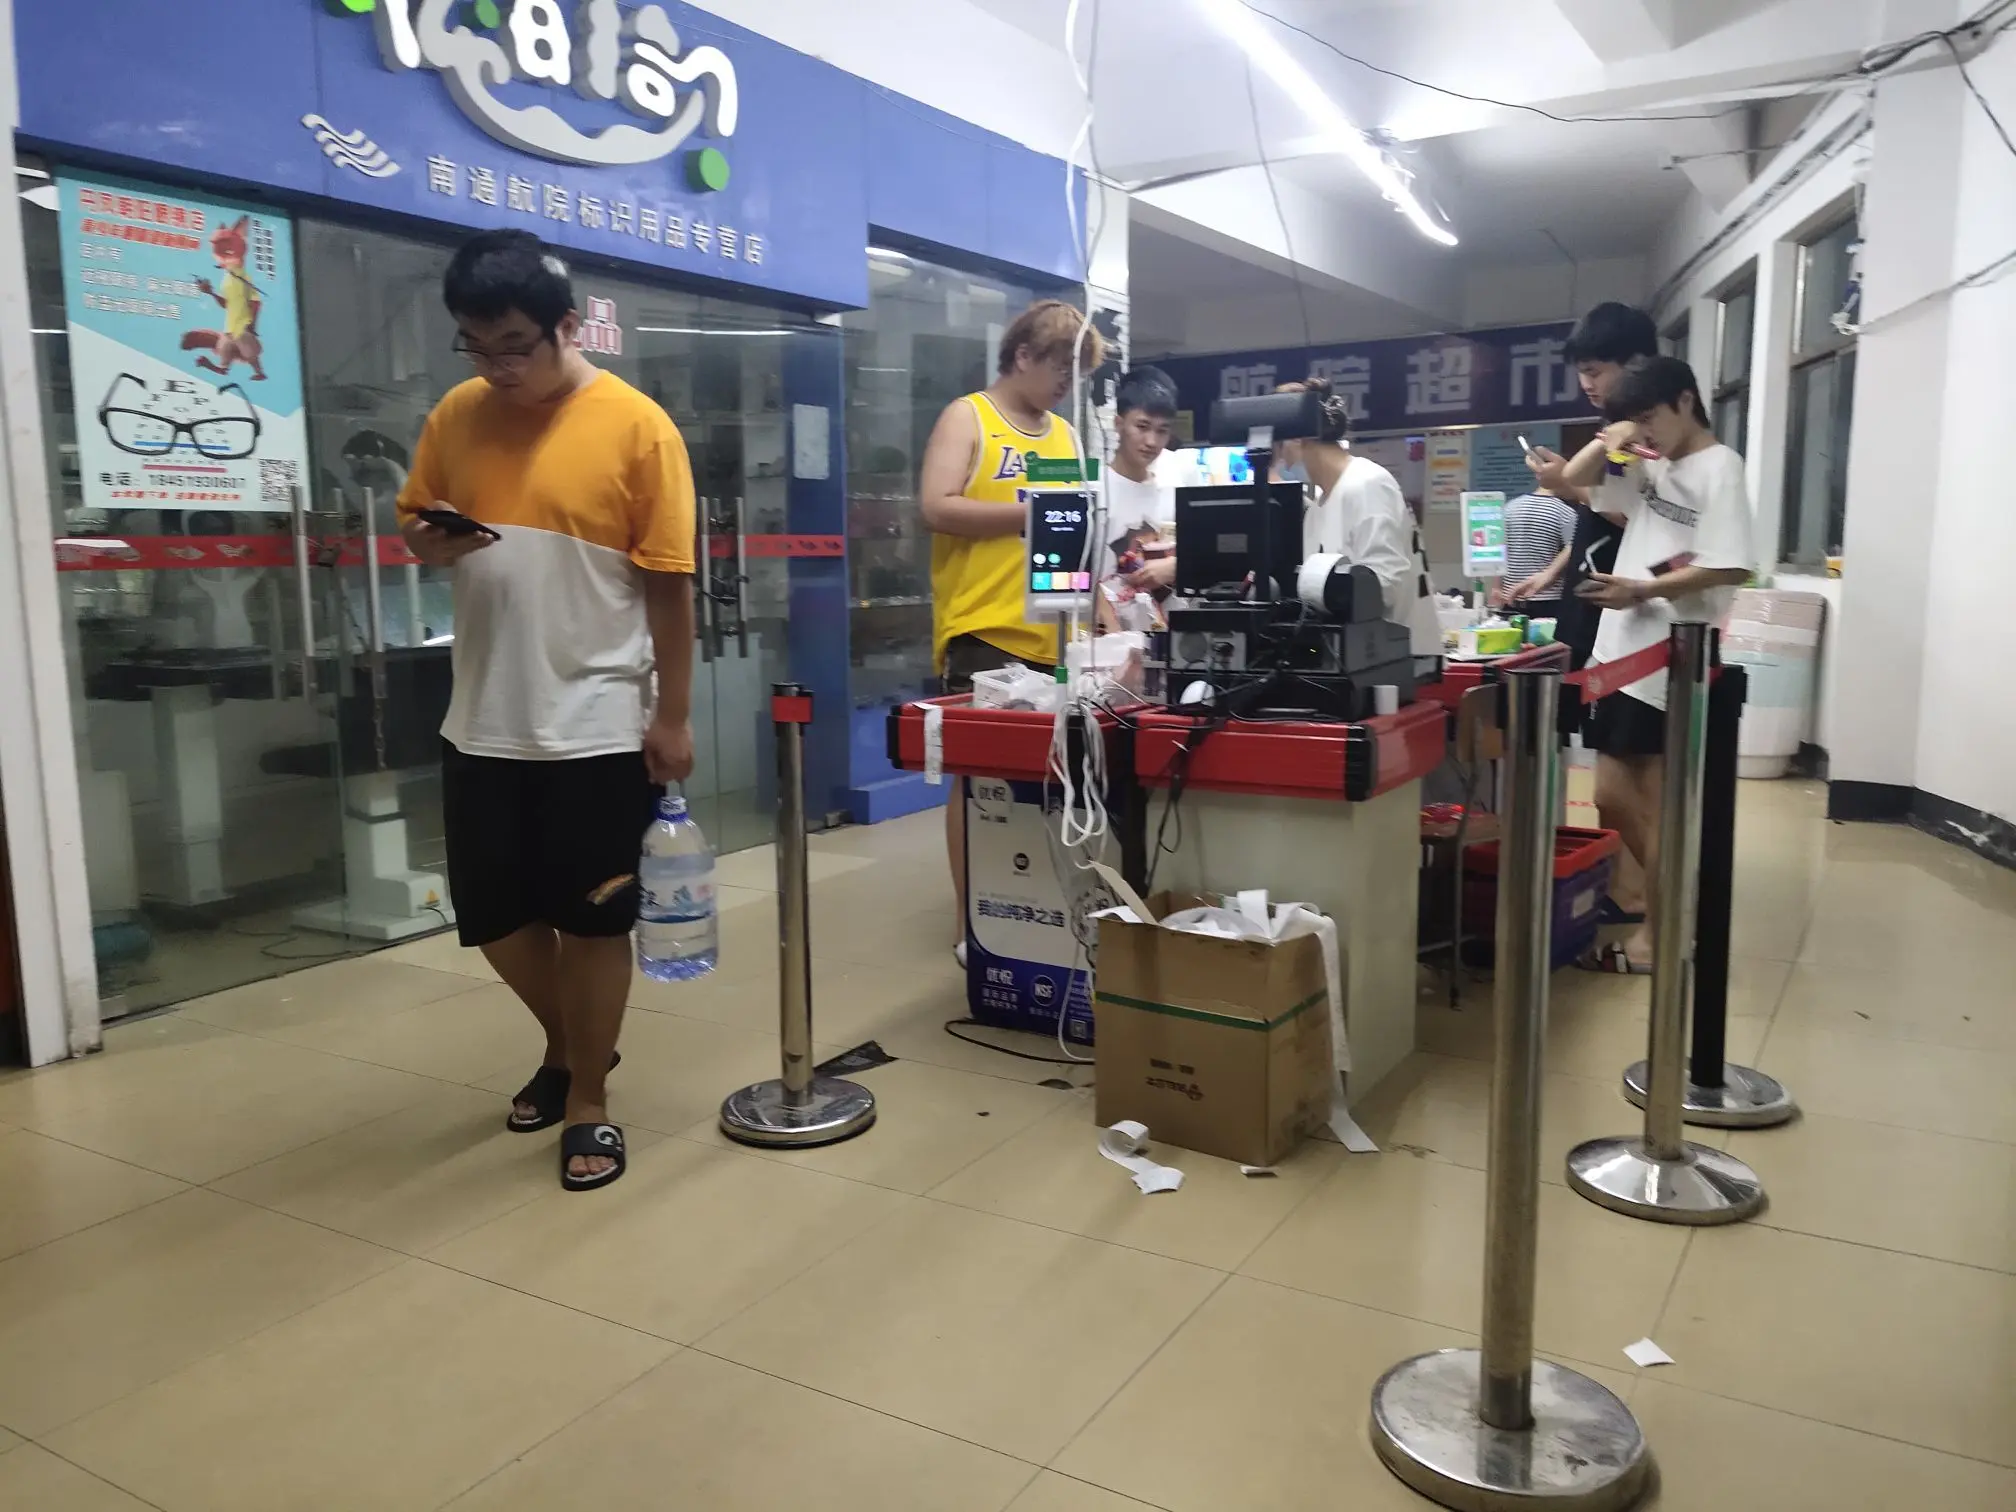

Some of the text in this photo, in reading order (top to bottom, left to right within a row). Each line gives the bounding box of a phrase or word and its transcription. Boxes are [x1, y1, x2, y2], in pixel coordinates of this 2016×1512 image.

[427, 154, 764, 266] 南通航院标识用品专营店
[1218, 337, 1582, 424] 航院超市
[1034, 983, 1053, 999] NSF
